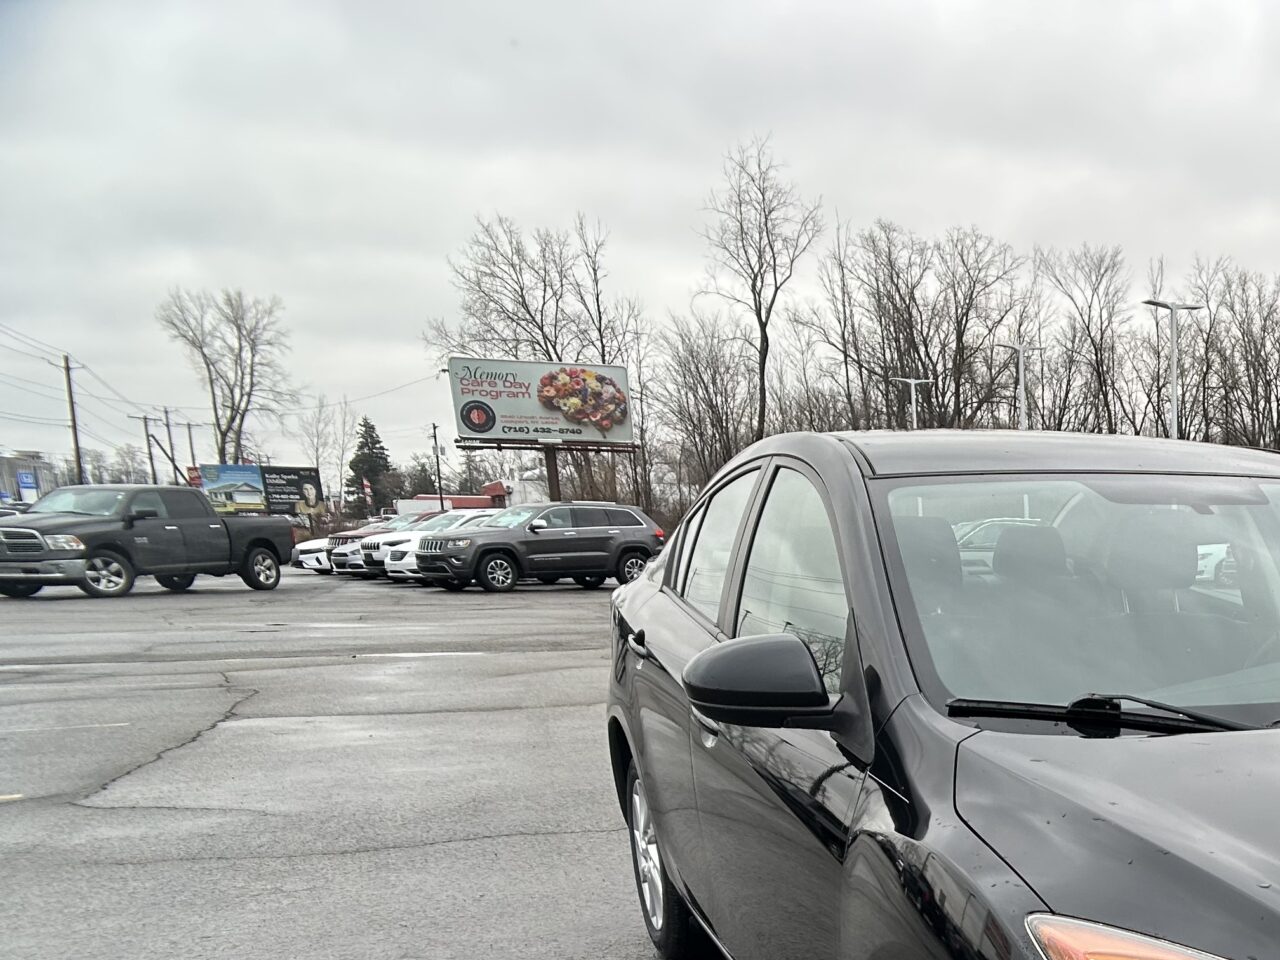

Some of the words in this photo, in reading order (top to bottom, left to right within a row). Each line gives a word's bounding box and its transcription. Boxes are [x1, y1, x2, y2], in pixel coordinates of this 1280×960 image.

[454, 366, 518, 382] Memory
[460, 378, 497, 388] Care
[503, 379, 532, 392] Day
[460, 387, 532, 400] Program
[501, 425, 530, 435] (716)
